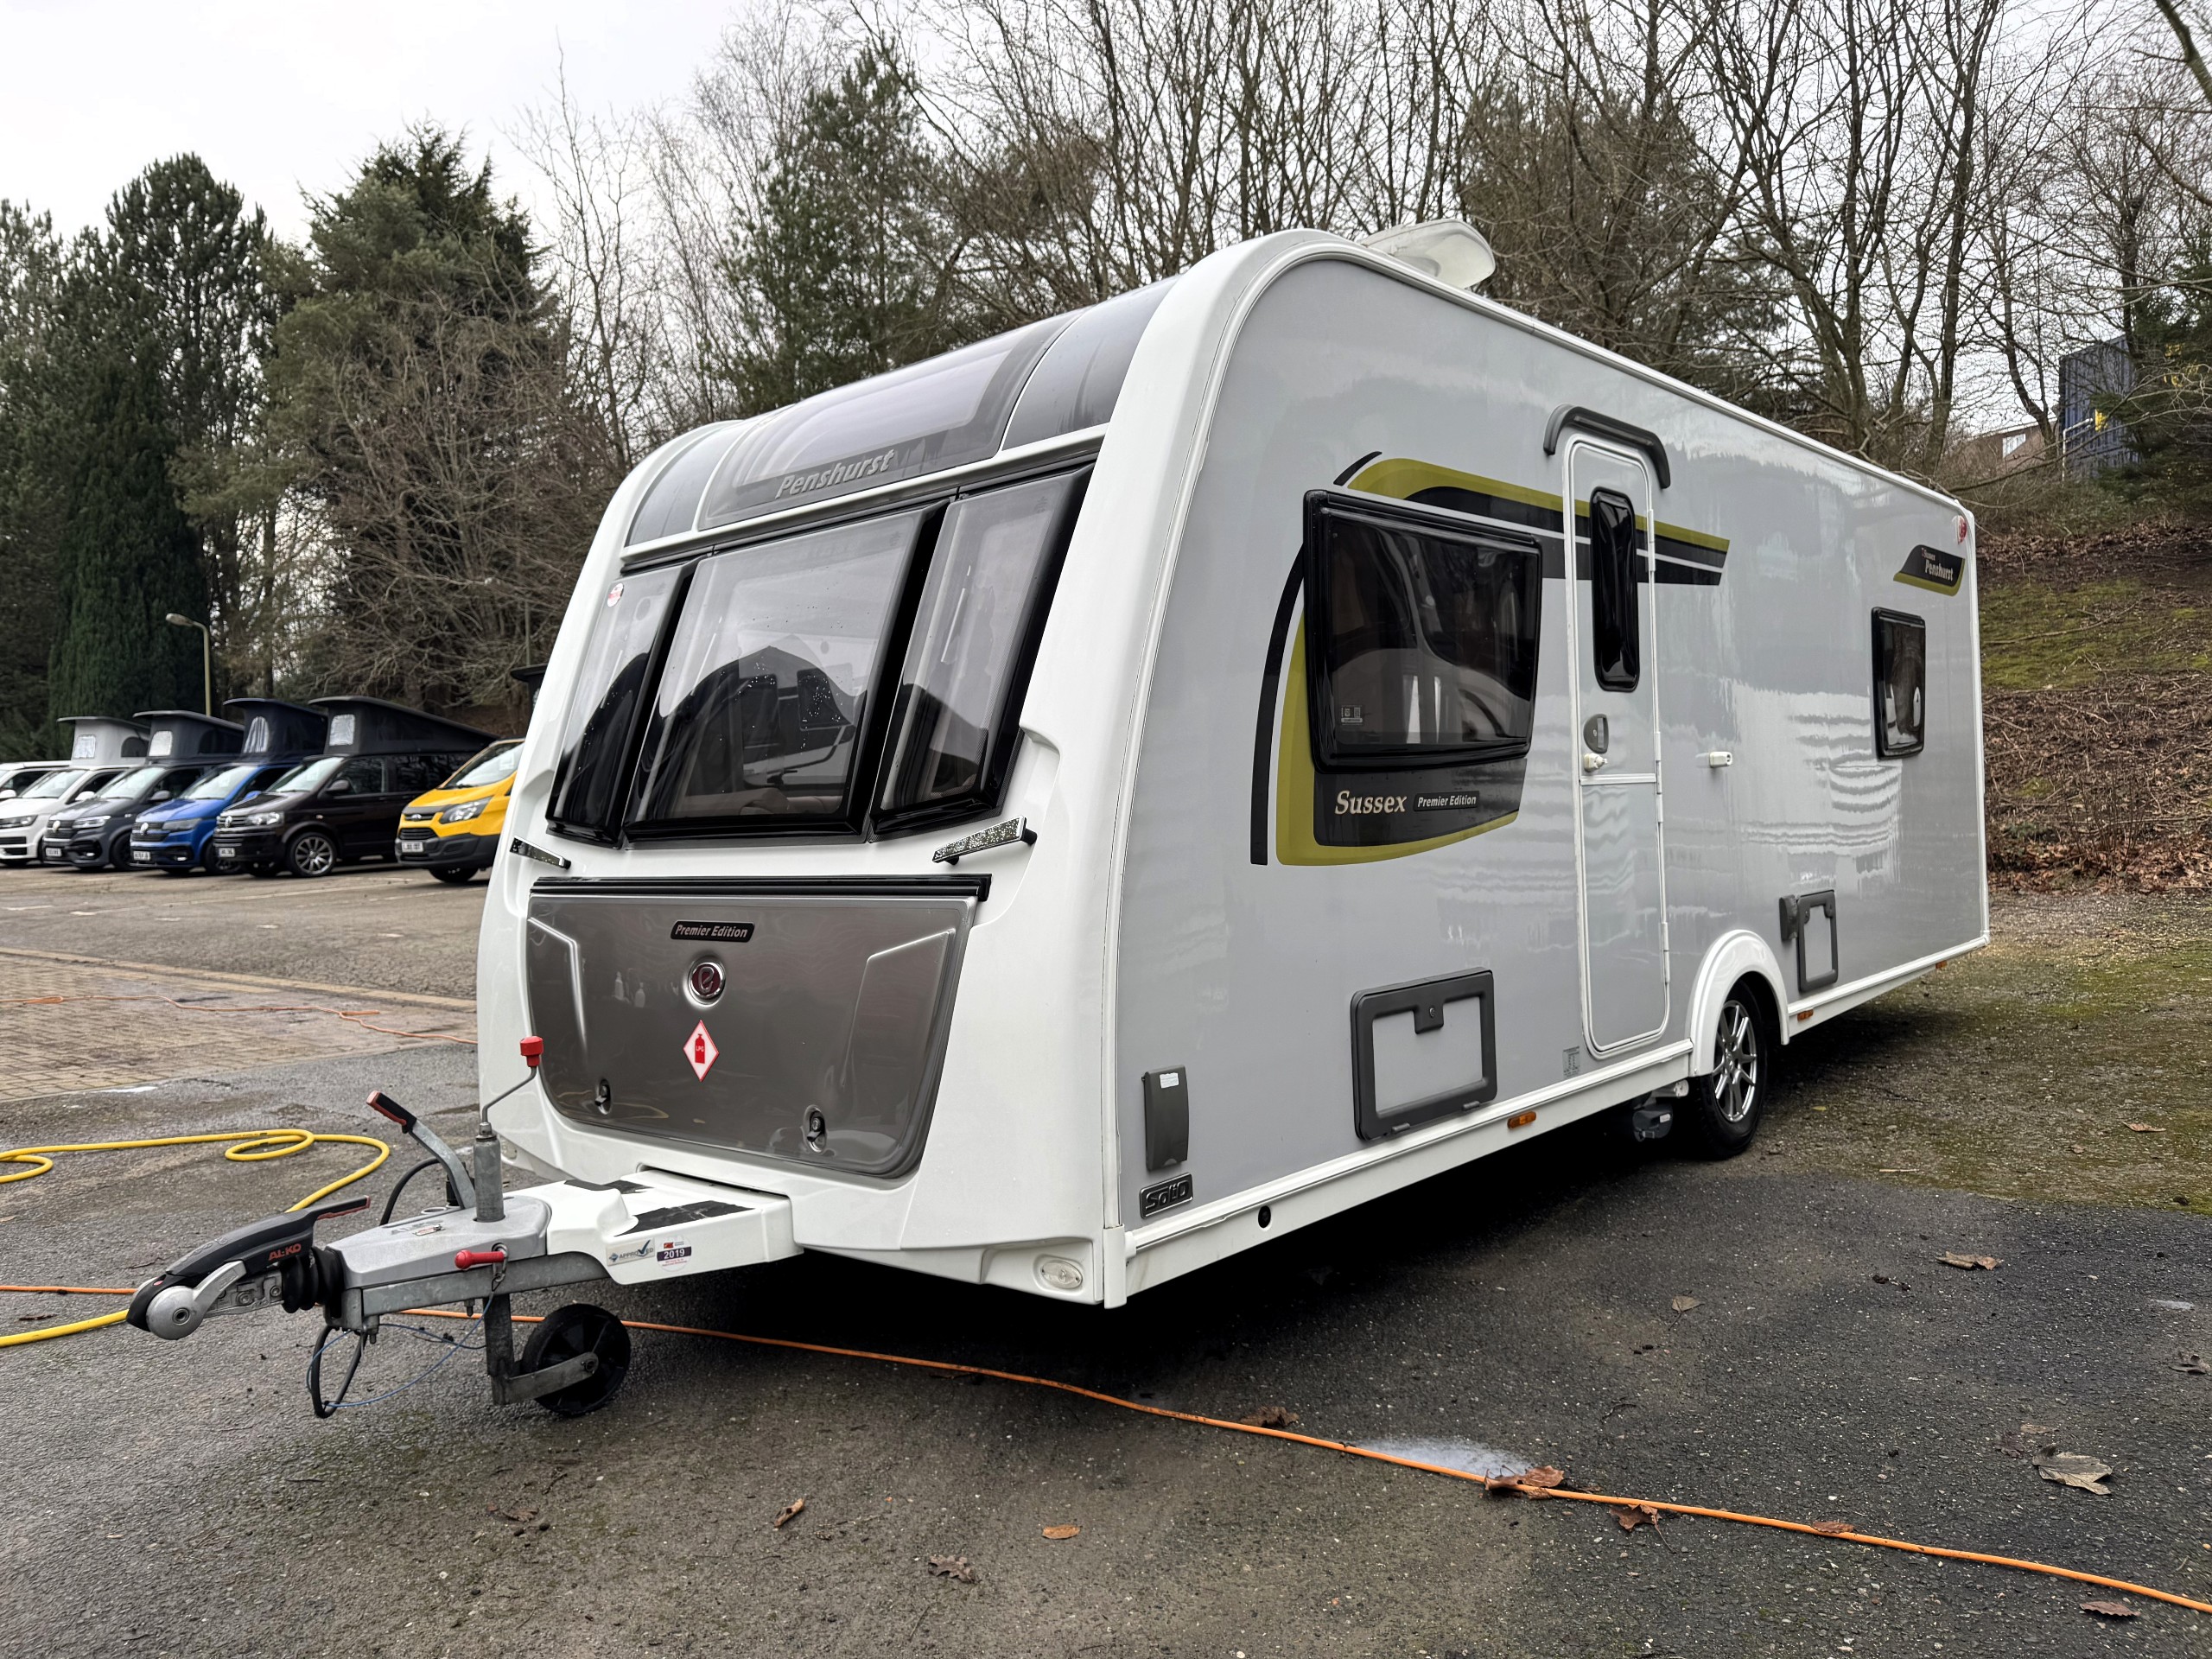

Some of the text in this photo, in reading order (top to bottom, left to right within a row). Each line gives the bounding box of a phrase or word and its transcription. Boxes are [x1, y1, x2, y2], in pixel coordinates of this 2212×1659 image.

[775, 448, 895, 499] Penshurst
[1925, 559, 1953, 581] Penshurst
[1334, 790, 1408, 815] Sussex
[1417, 794, 1477, 808] Premier Edition
[675, 924, 748, 938] Premier Edition
[664, 1248, 686, 1260] 2019
